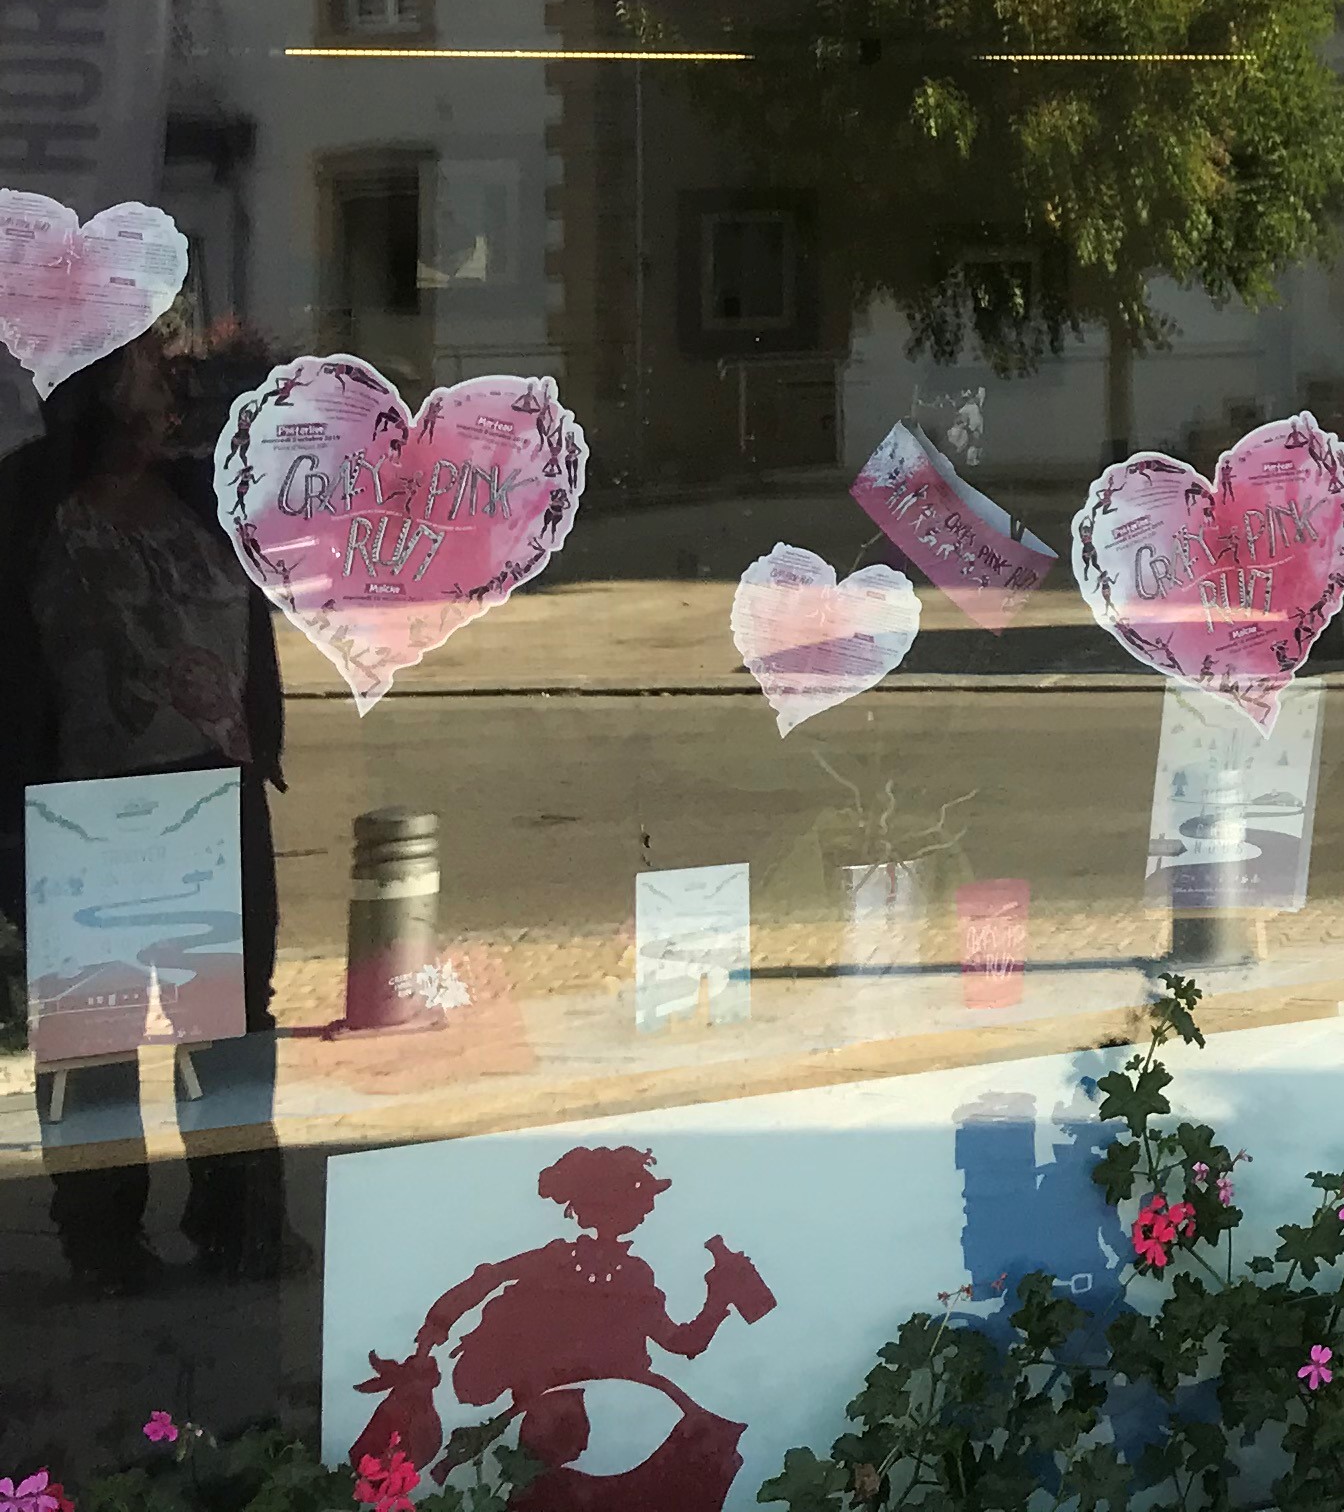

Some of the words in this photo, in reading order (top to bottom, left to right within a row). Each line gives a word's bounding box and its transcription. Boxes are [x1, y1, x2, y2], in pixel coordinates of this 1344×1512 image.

[277, 447, 388, 521] CRAZY
[424, 459, 539, 522] PINK
[342, 516, 446, 582] RUN
[1243, 496, 1328, 561] PINK
[1134, 524, 1217, 600] CRAZY
[1200, 568, 1274, 634] RUN
